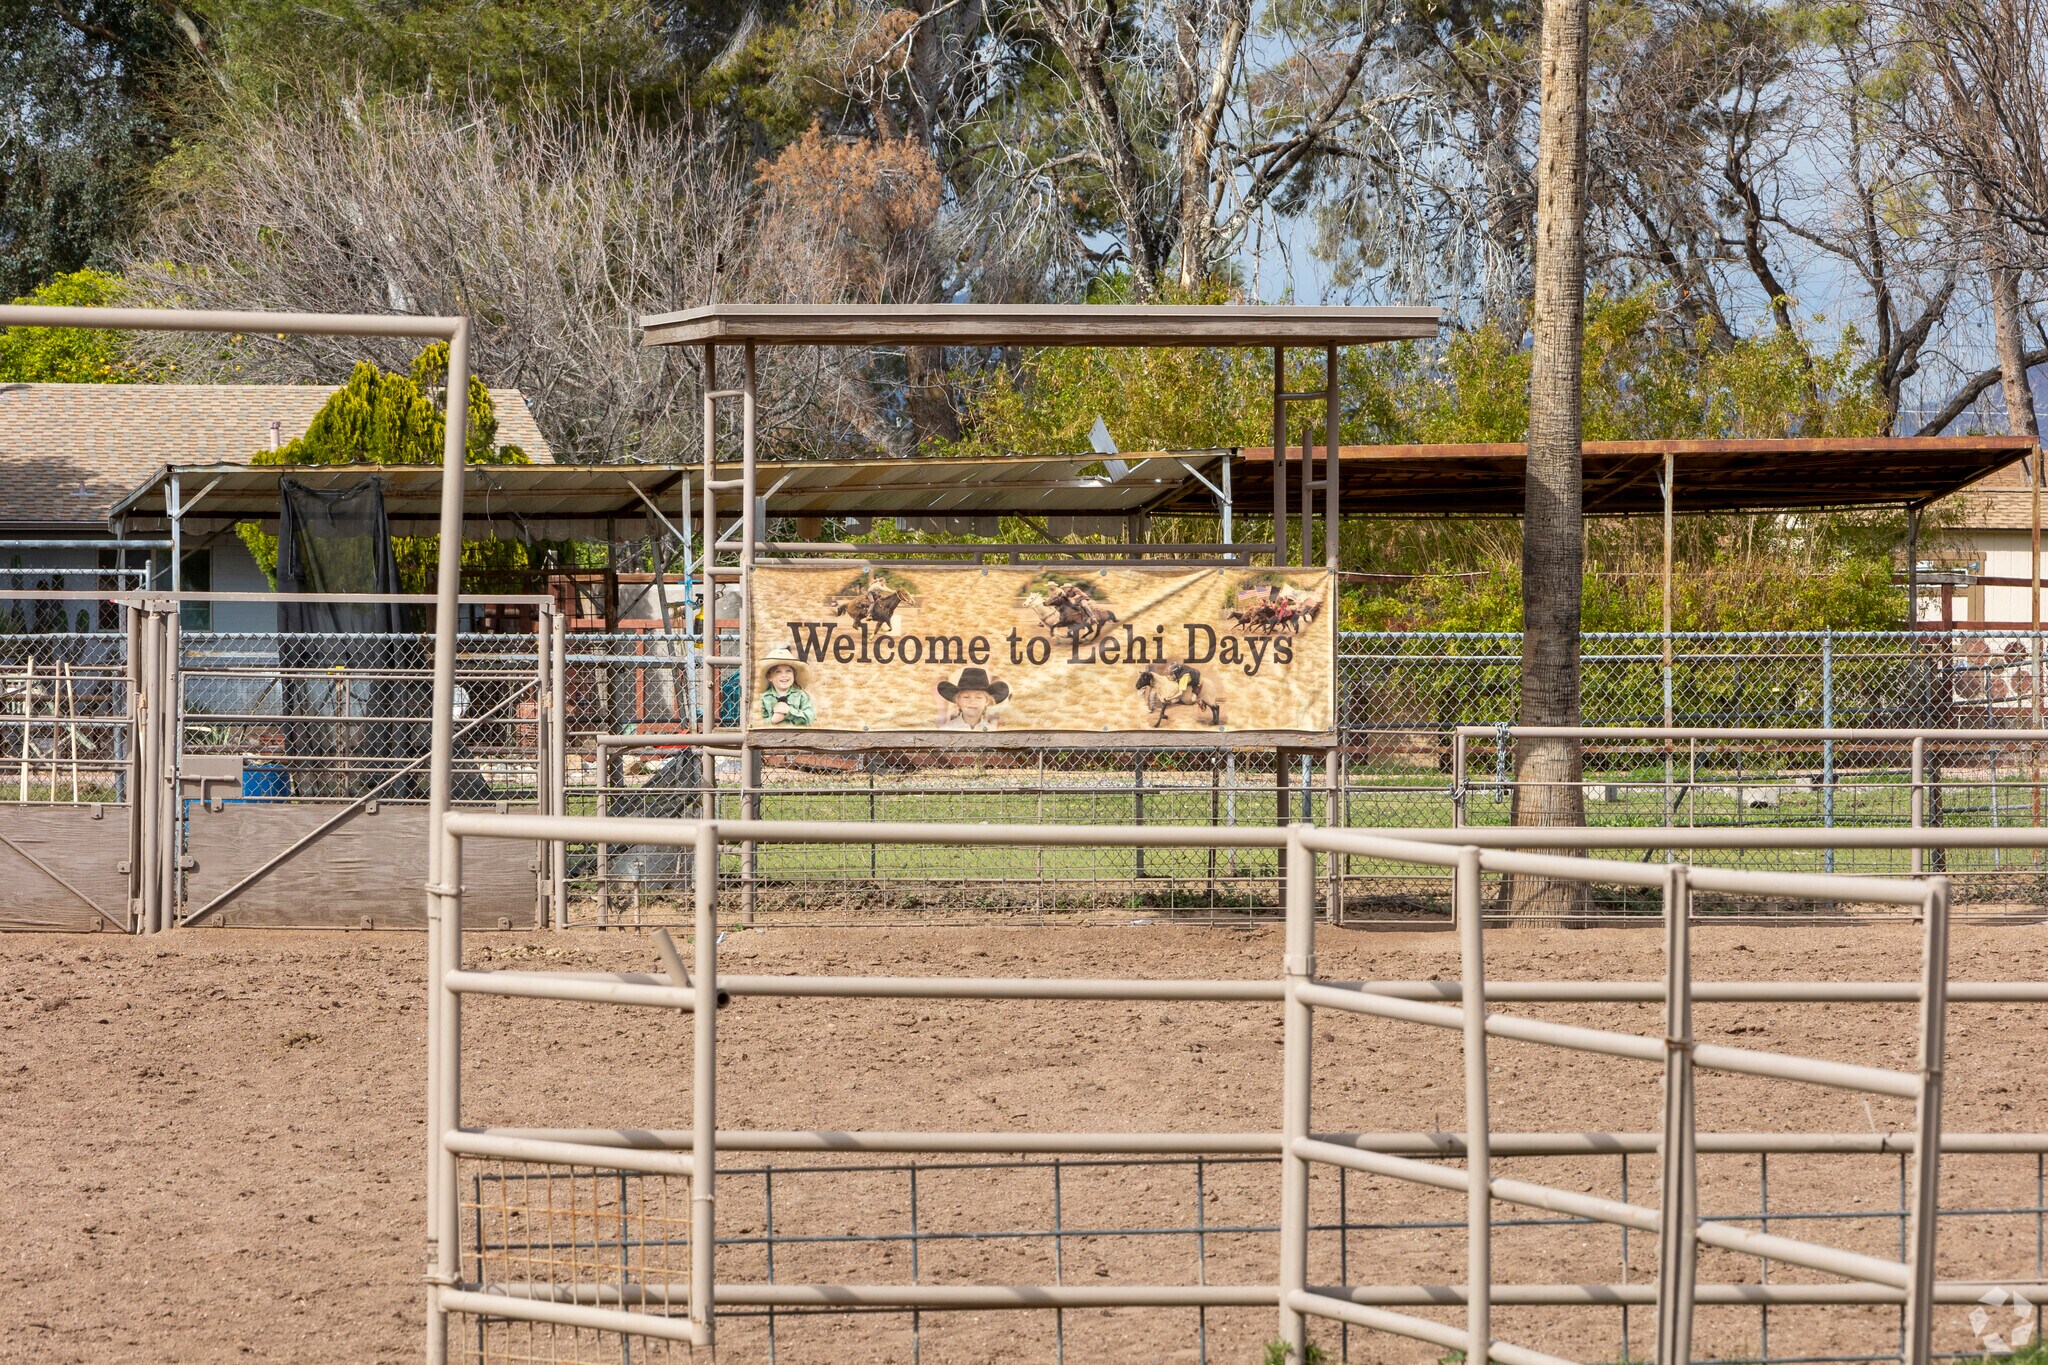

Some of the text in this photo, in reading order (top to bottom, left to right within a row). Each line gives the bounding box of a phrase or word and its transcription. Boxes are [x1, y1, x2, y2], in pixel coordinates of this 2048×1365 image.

[788, 622, 1294, 676] Welcome to Lehi Days
